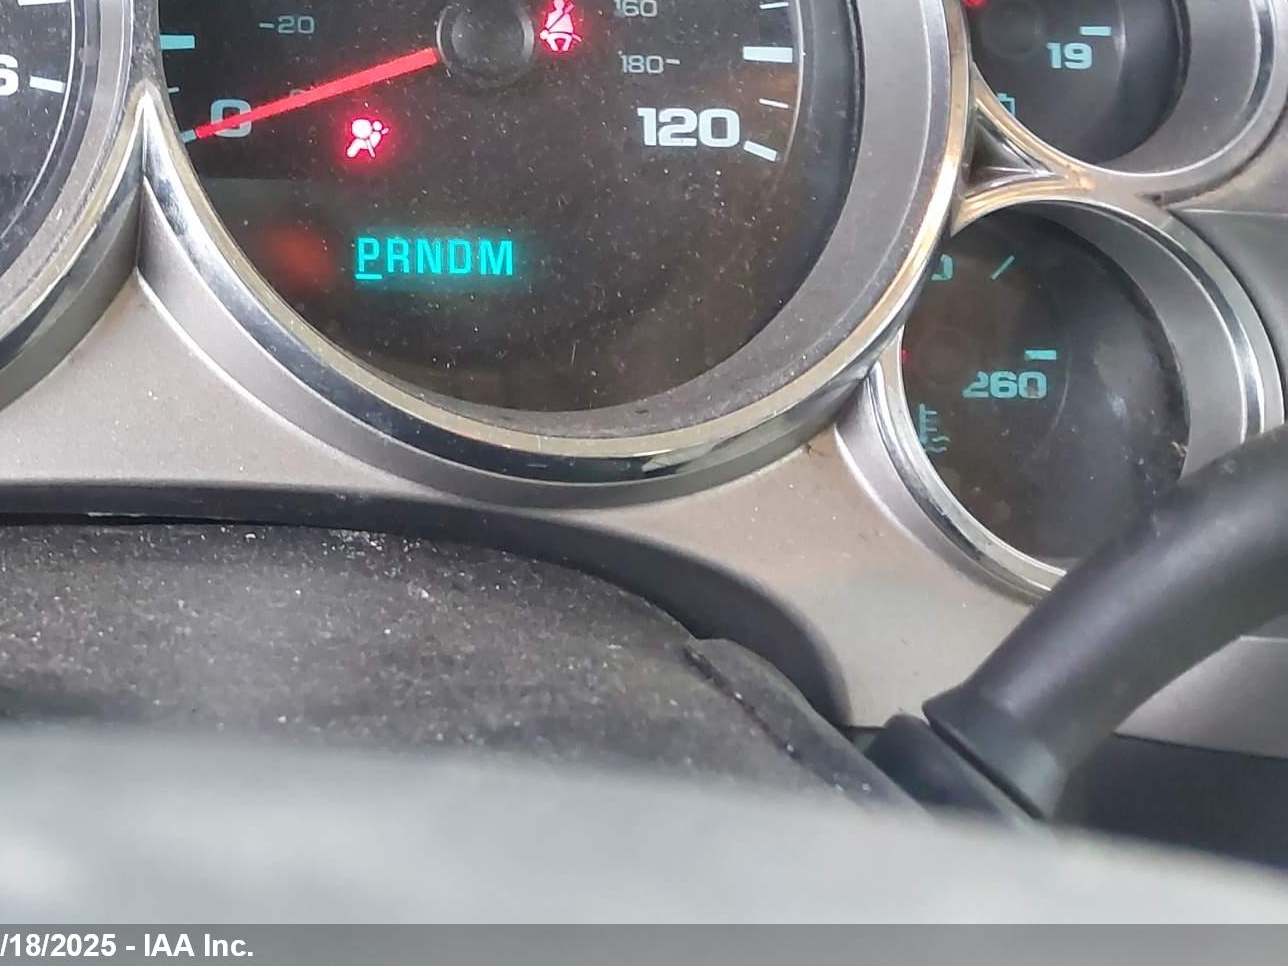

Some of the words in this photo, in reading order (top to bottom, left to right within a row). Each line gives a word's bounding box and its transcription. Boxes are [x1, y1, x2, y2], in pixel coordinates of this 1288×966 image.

[278, 15, 315, 34] 20
[620, 54, 664, 74] 180
[1046, 42, 1093, 70] 19
[210, 98, 252, 138] 0
[636, 107, 741, 148] 120
[356, 237, 513, 278] PRNDM
[962, 371, 1047, 399] 260
